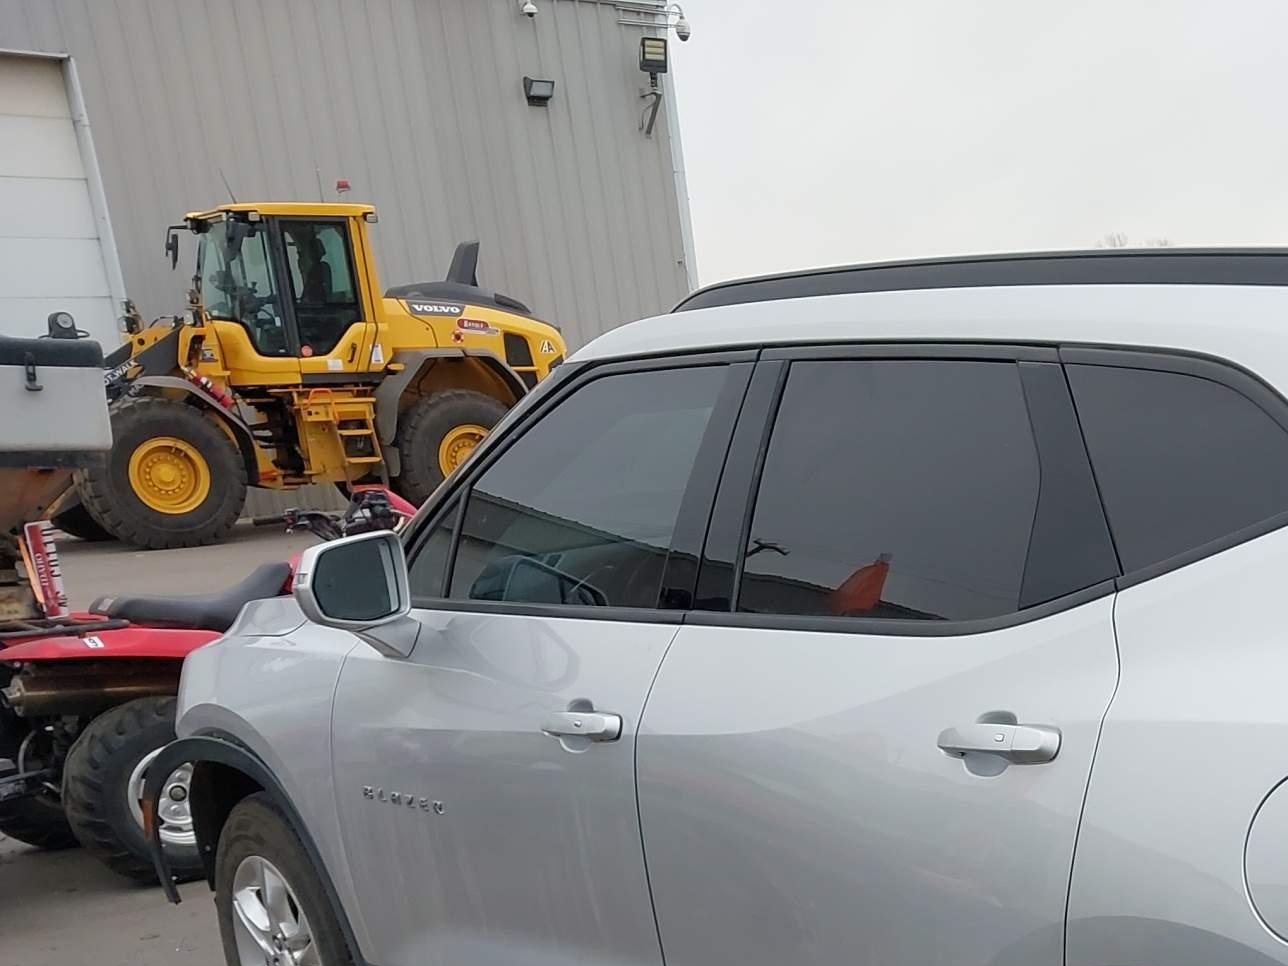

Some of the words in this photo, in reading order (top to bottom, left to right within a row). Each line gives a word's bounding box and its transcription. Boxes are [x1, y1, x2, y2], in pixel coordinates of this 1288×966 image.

[411, 304, 460, 313] VOLVO
[35, 552, 49, 586] IDAHO
[363, 784, 445, 815] BLAZER
